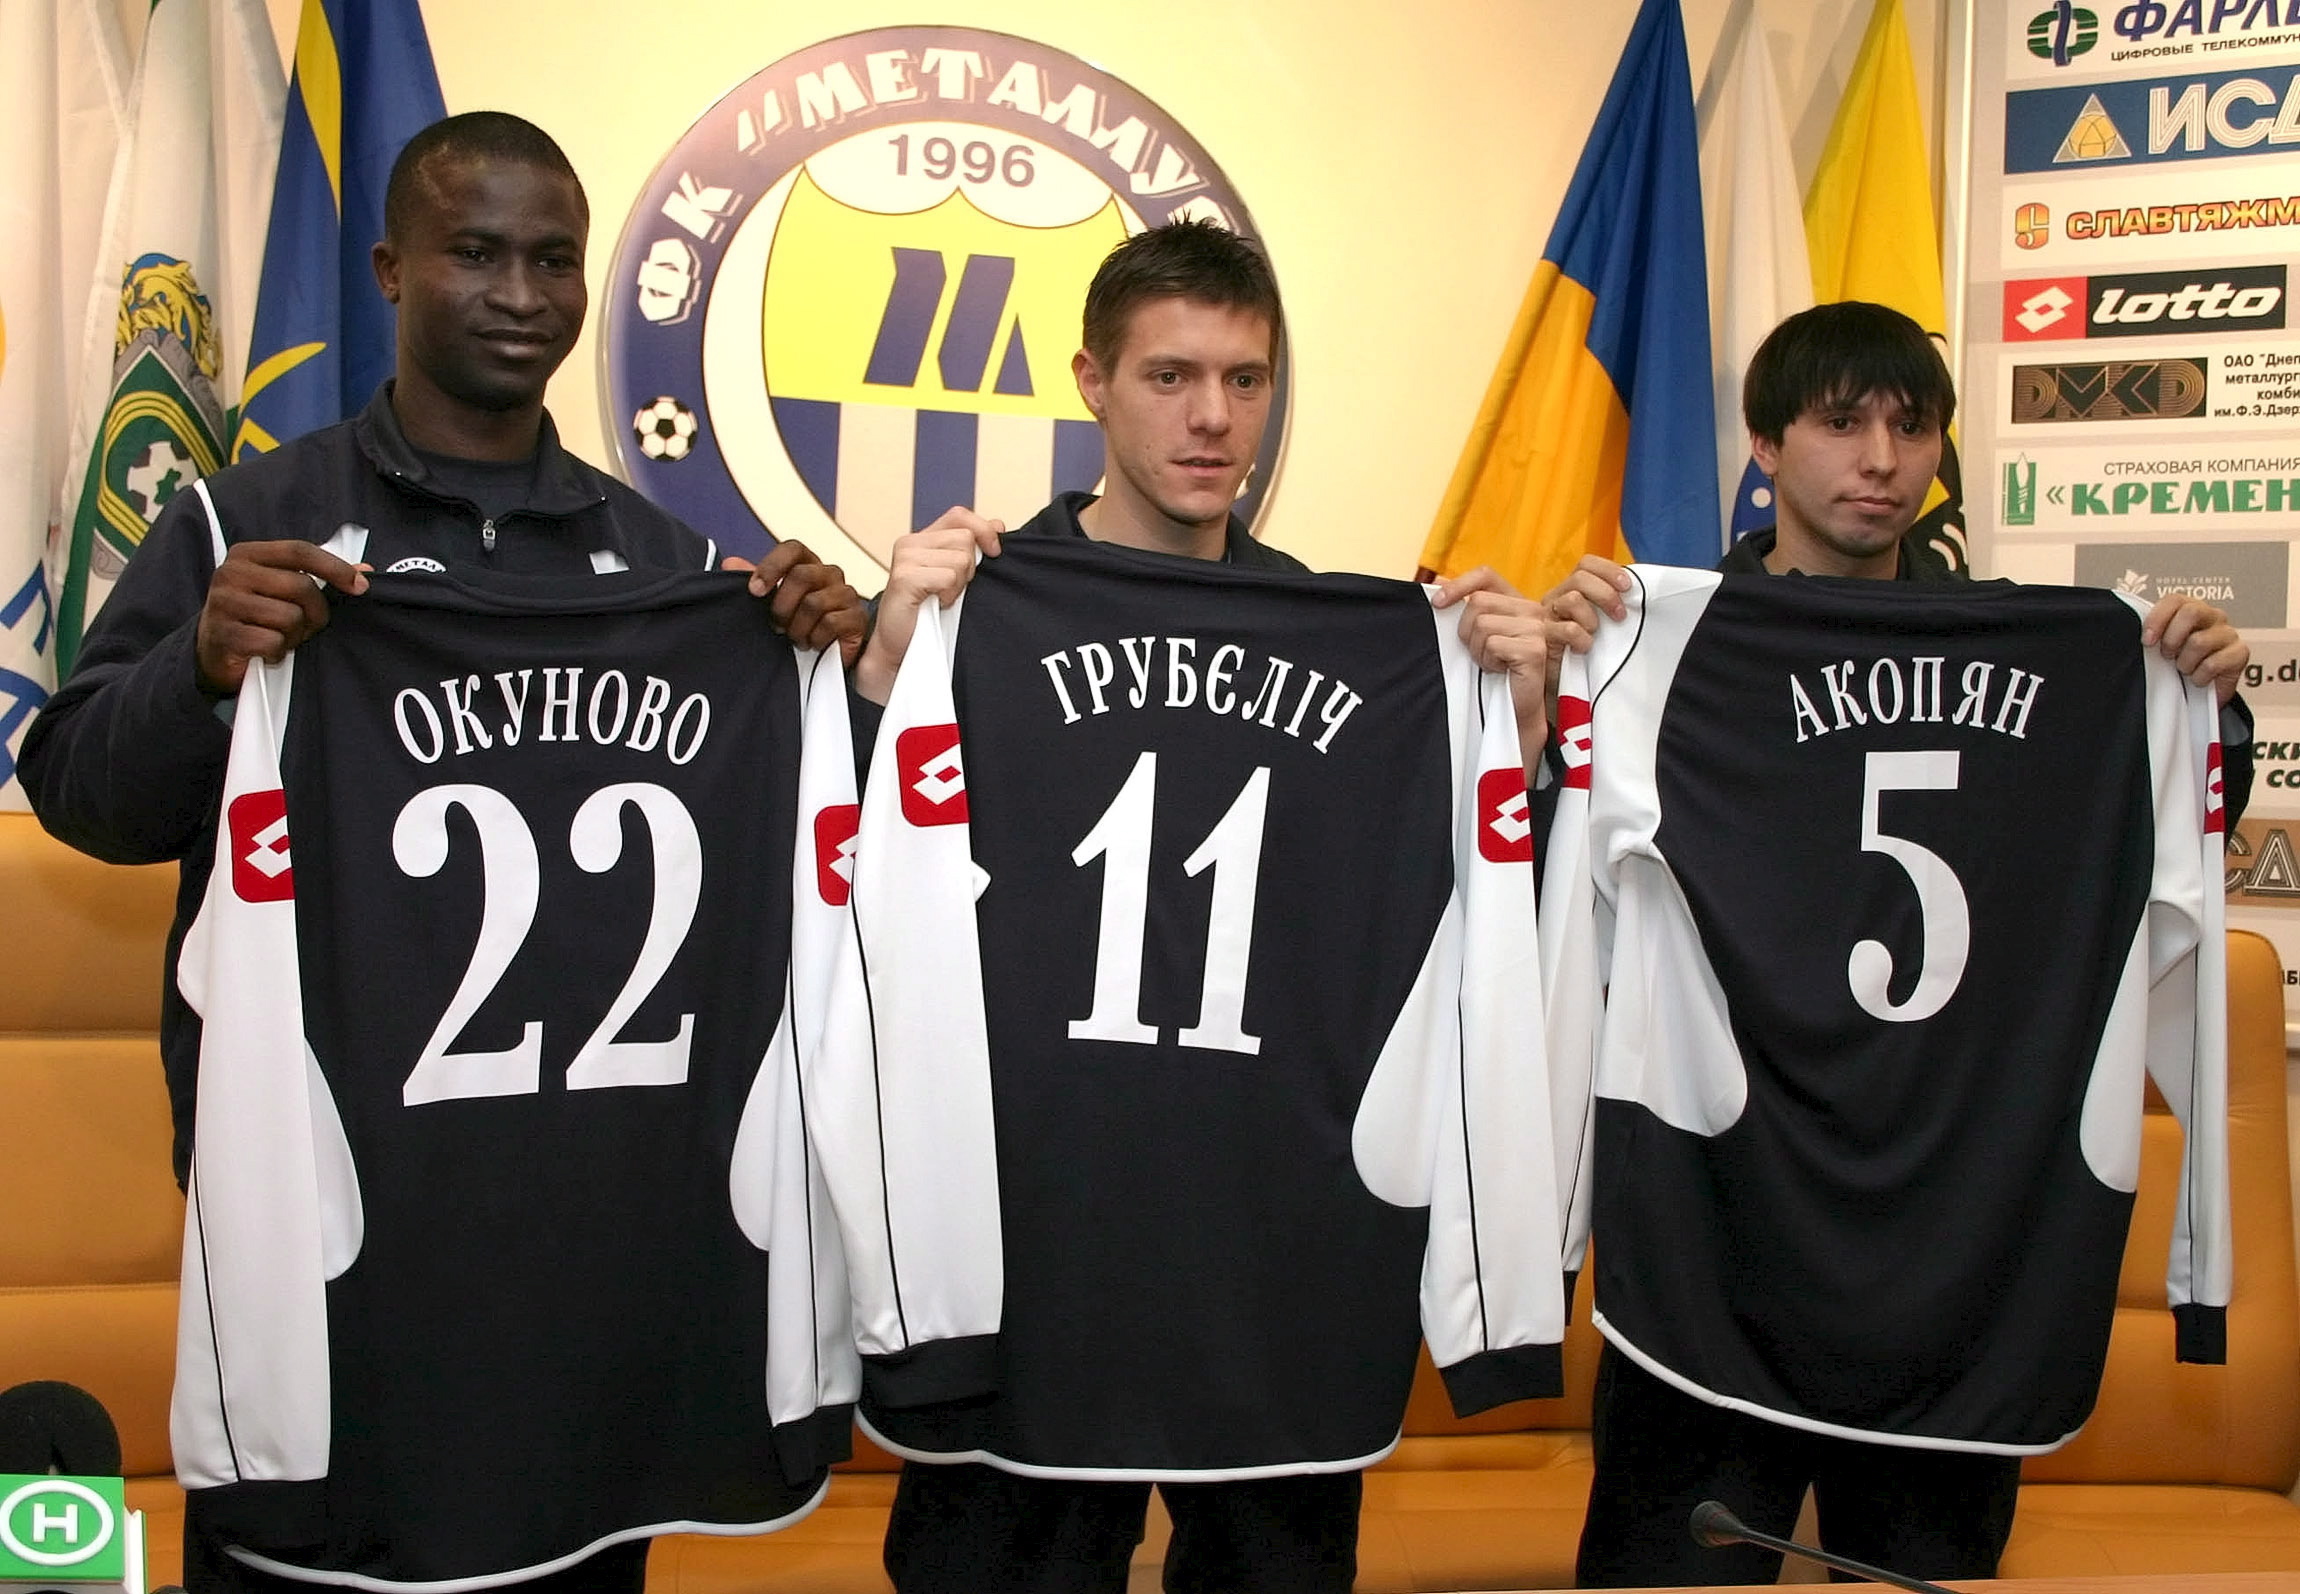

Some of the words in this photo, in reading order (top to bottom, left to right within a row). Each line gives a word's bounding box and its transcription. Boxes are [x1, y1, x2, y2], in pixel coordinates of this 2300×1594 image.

[2111, 44, 2194, 61] ЦИФРОВЫЕ
[888, 134, 1035, 187] 1996
[2066, 195, 2300, 240] СЛАВТЯЖМ
[637, 171, 738, 324] ФК
[2092, 283, 2282, 324] lotto
[2224, 354, 2254, 368] ОАО
[2214, 404, 2300, 417] им.Ф.Э.Дзер
[2104, 460, 2202, 476] СТРАХОВАЯ
[1041, 636, 1363, 754] ГРУБЄЛІЧ
[1790, 657, 2045, 743] АКОПЯН
[2245, 659, 2300, 688] g.d
[394, 668, 711, 766] ОКУНОВО
[1067, 751, 1271, 1055] 11
[1848, 750, 1970, 1022] 5
[392, 782, 703, 1107] 22
